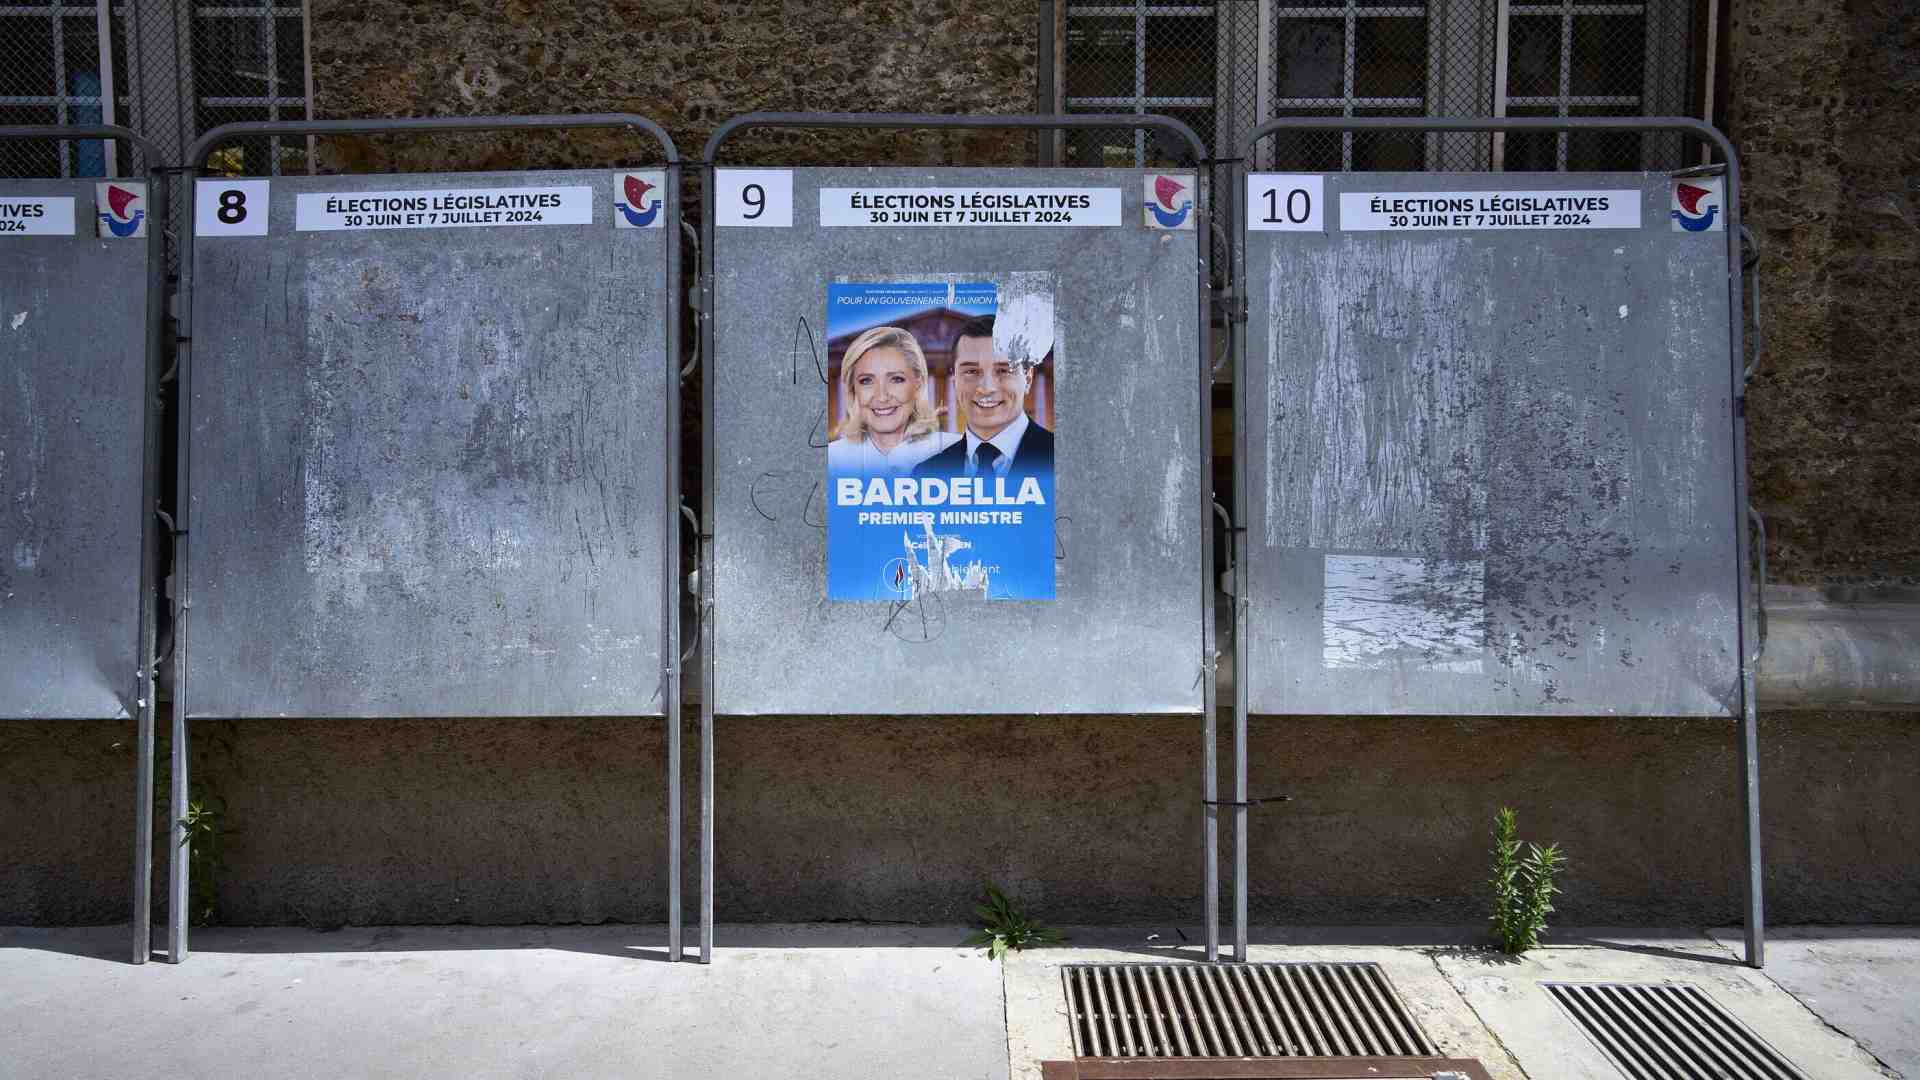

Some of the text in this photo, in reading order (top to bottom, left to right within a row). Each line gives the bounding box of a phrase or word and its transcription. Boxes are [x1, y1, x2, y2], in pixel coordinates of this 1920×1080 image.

[217, 189, 247, 224] 8
[326, 193, 561, 213] ÉLECTIONS LÉGISLATIVES
[742, 184, 766, 219] 9
[850, 192, 1090, 209] ÉLECTIONS LÉGISLATIVES
[1261, 188, 1312, 224] 10
[1370, 195, 1609, 213] ÉLECTIONS LÉGISLATIVES
[344, 210, 543, 226] 30 JUIN ET 7 JUILLET 2024
[870, 211, 1073, 223] 30 JUIN ET 7 JUILLET 2024
[1390, 213, 1591, 227] 30 JUIN ET 7 JUILLET 2024
[837, 296, 863, 305] POUR
[864, 296, 878, 305] UN
[955, 296, 993, 305] D'UNION
[837, 478, 1046, 505] BARDELLA
[859, 511, 1023, 525] PREMIER MINISTRE
